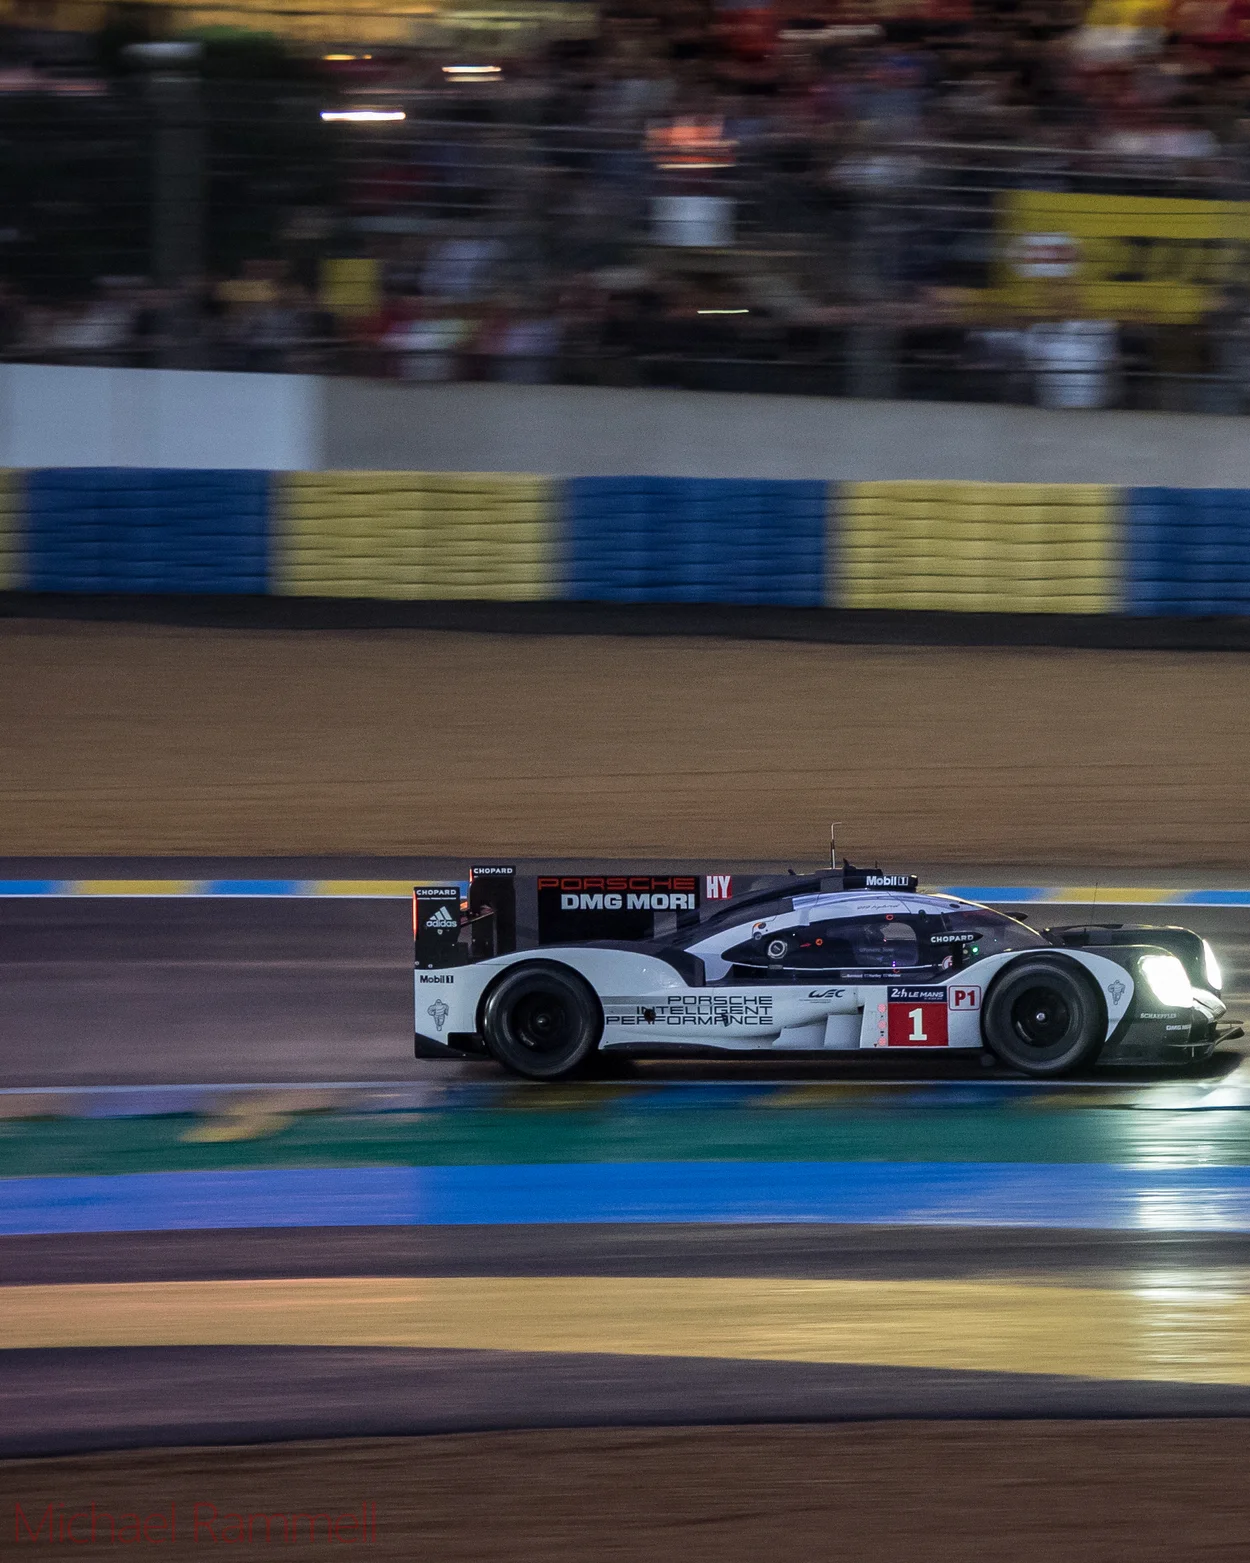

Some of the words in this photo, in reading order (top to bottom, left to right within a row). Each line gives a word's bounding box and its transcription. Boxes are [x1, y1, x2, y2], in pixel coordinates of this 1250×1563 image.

[538, 878, 695, 890] PORSCHE
[866, 875, 897, 886] Mobil
[706, 875, 731, 898] HY
[561, 893, 622, 910] DMG
[627, 893, 695, 910] MORI
[426, 919, 457, 928] adidas
[930, 934, 974, 943] CHOPARD
[420, 975, 445, 983] Mobil
[808, 989, 846, 998] WEC
[954, 990, 975, 1006] P1
[667, 996, 773, 1005] PORSCHE
[636, 1006, 773, 1015] INTELLIGENT
[606, 1016, 773, 1025] PERFORMANCE
[908, 1008, 928, 1041] 1
